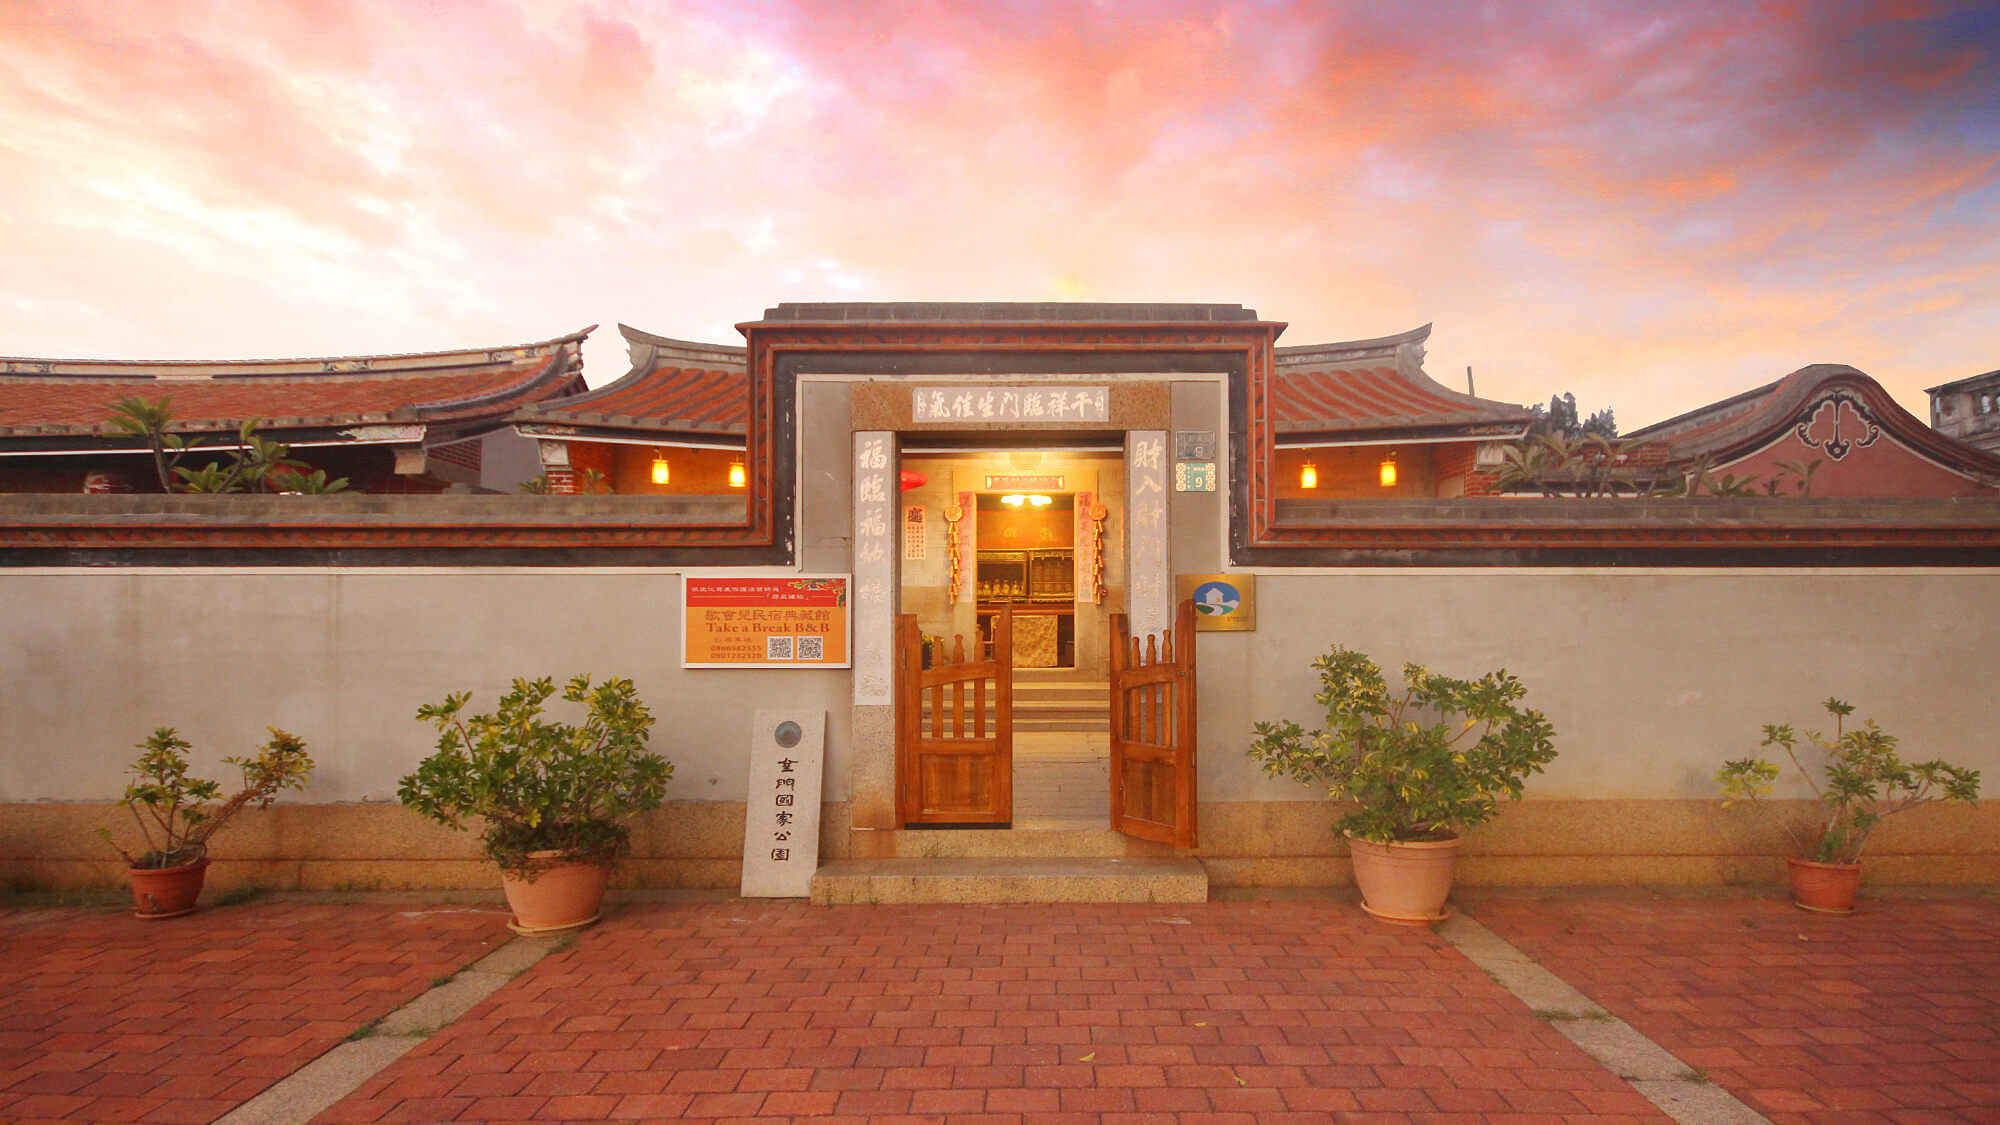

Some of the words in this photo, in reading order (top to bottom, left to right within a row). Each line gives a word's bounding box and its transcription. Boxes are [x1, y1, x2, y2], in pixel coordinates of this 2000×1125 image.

[1195, 476, 1203, 488] 9
[704, 609, 831, 621] 歇會兒民宿典藏館
[705, 622, 739, 633] Take
[752, 622, 791, 633] Break
[794, 622, 830, 633] B&B
[771, 757, 799, 862] 金門國家公園
